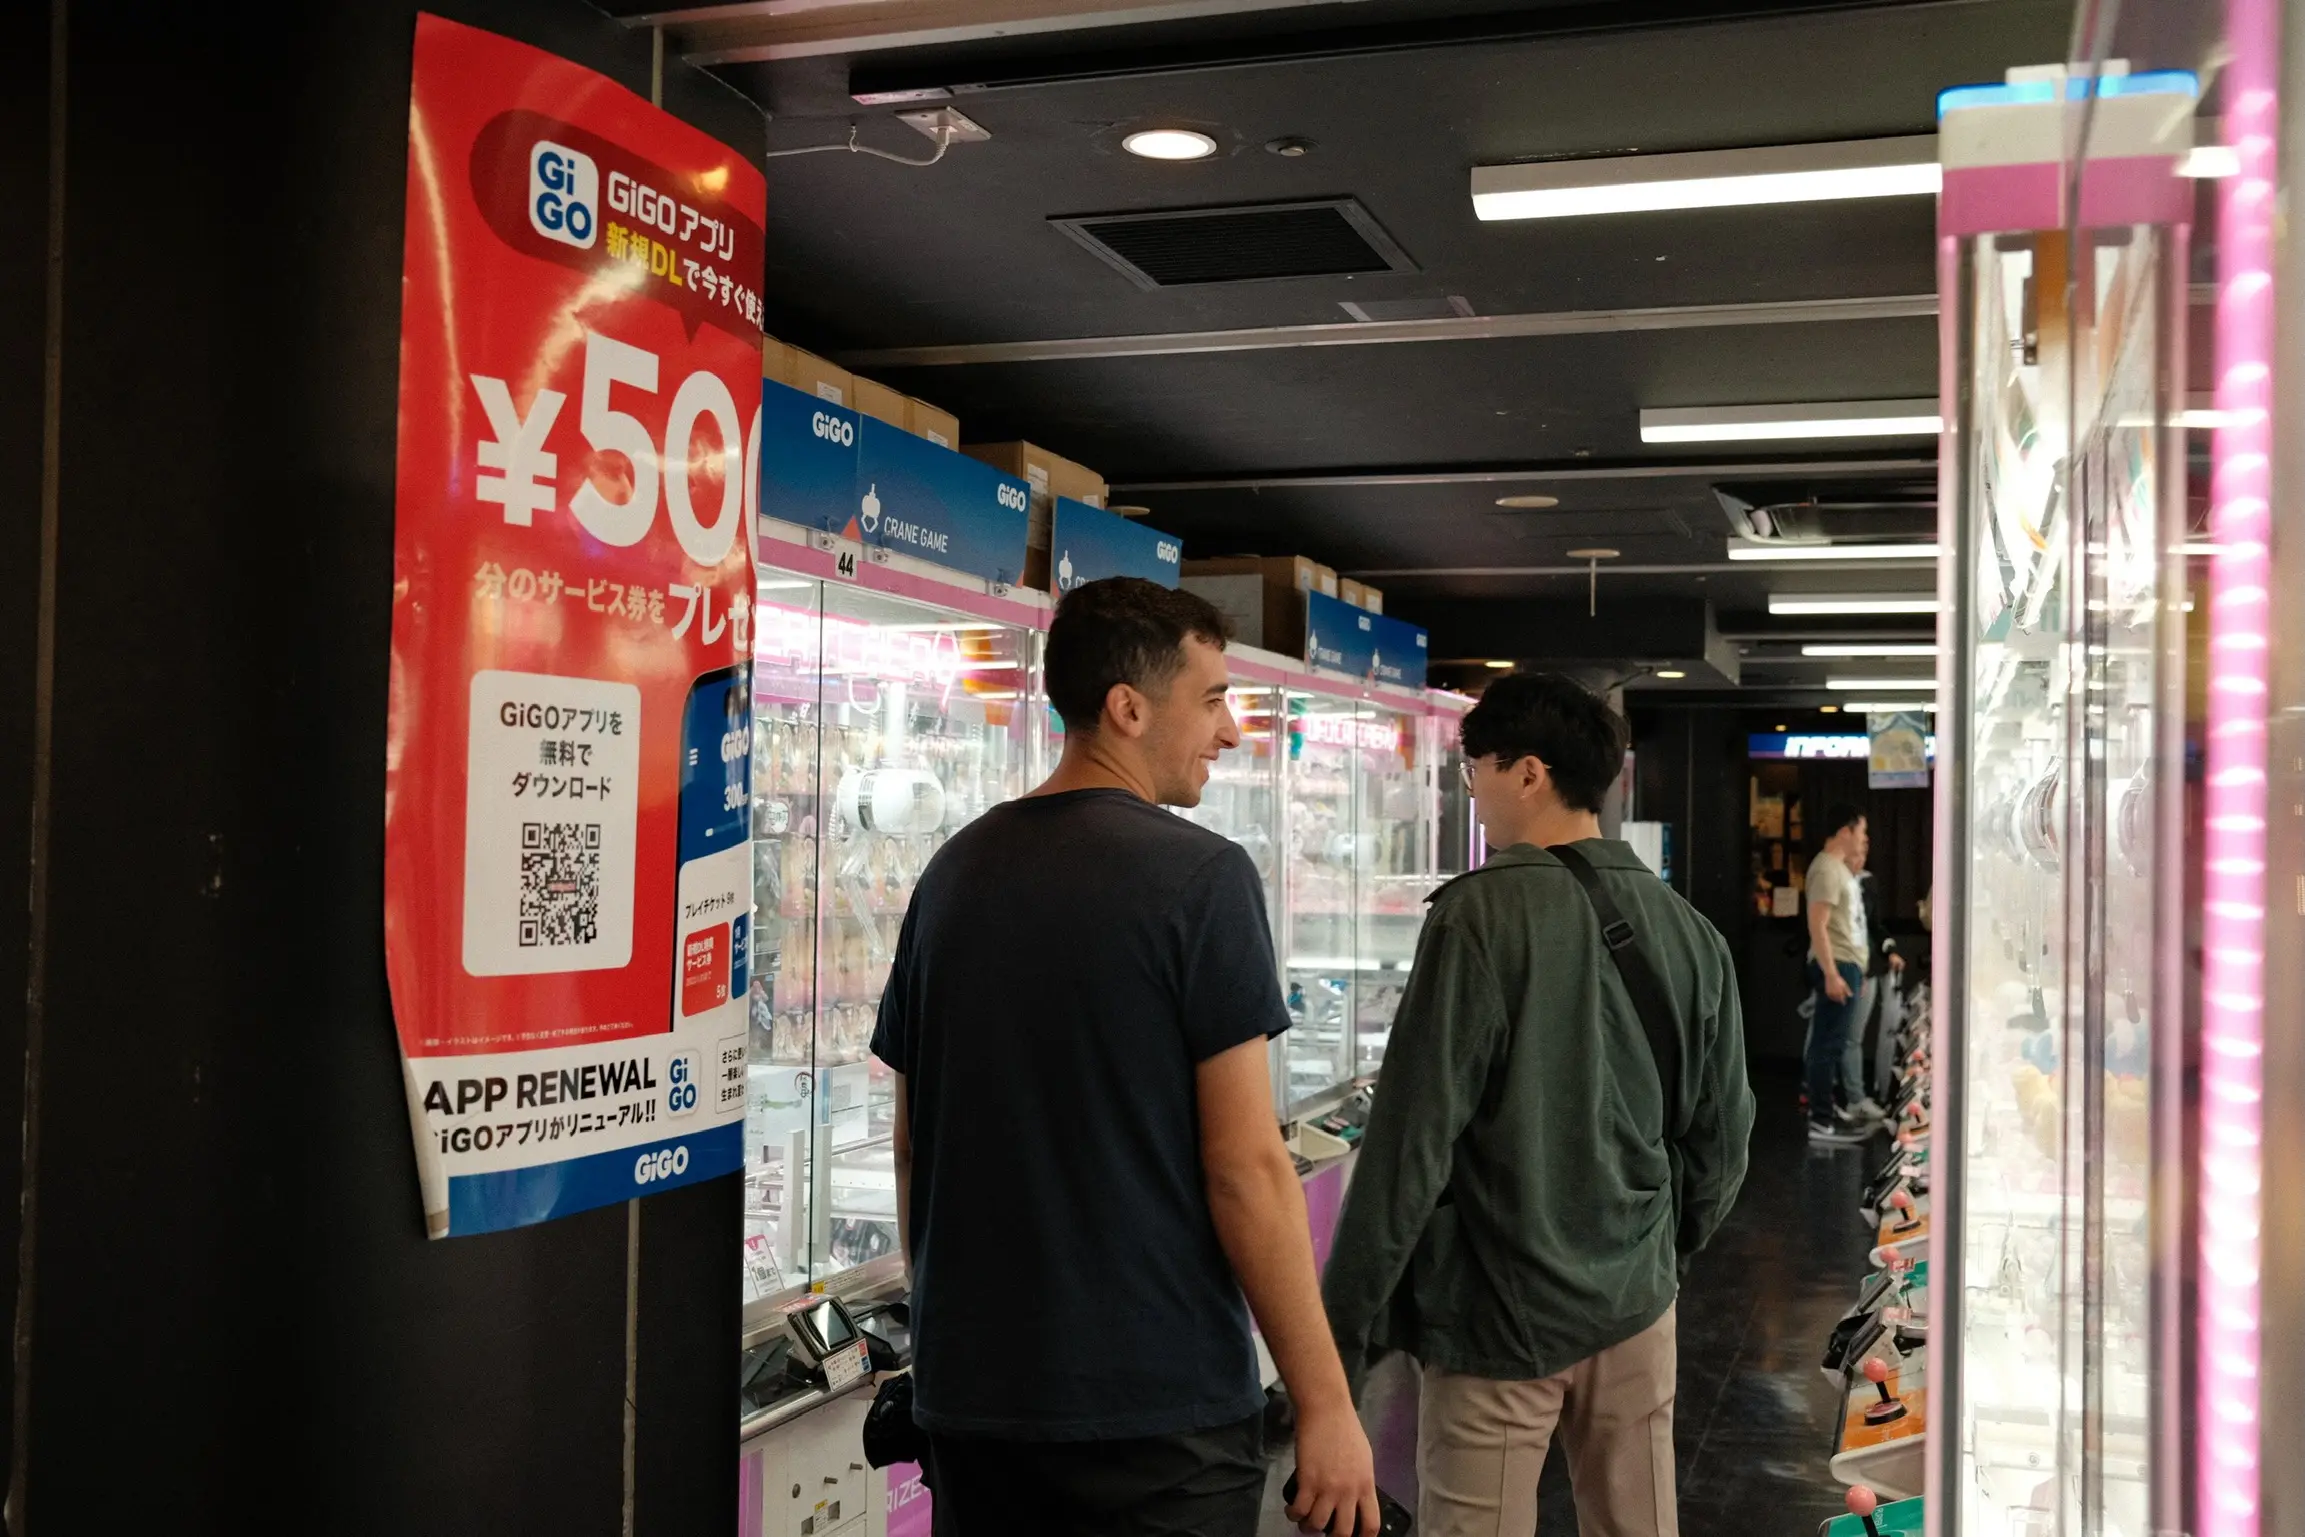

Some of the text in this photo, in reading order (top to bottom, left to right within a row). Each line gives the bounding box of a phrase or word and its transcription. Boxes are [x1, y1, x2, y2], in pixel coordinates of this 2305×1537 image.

[537, 151, 574, 195] Gi
[536, 192, 592, 241] GO
[812, 410, 854, 447] GiGO
[469, 330, 762, 576] ¥50
[997, 482, 1027, 512] GiGO
[884, 516, 949, 553] CRANE GAME
[1156, 540, 1178, 564] GiGO
[838, 551, 854, 577] 44
[499, 701, 623, 736] GiGOアプリを
[539, 739, 593, 768] 無料で
[512, 771, 612, 802] ダウンロード
[423, 1057, 657, 1116] APP RENEWAL
[670, 1057, 688, 1084] Gi
[669, 1083, 697, 1112] GO
[434, 1099, 657, 1154] iGOアプリがリニューアル!!
[634, 1145, 689, 1185] GiGO
